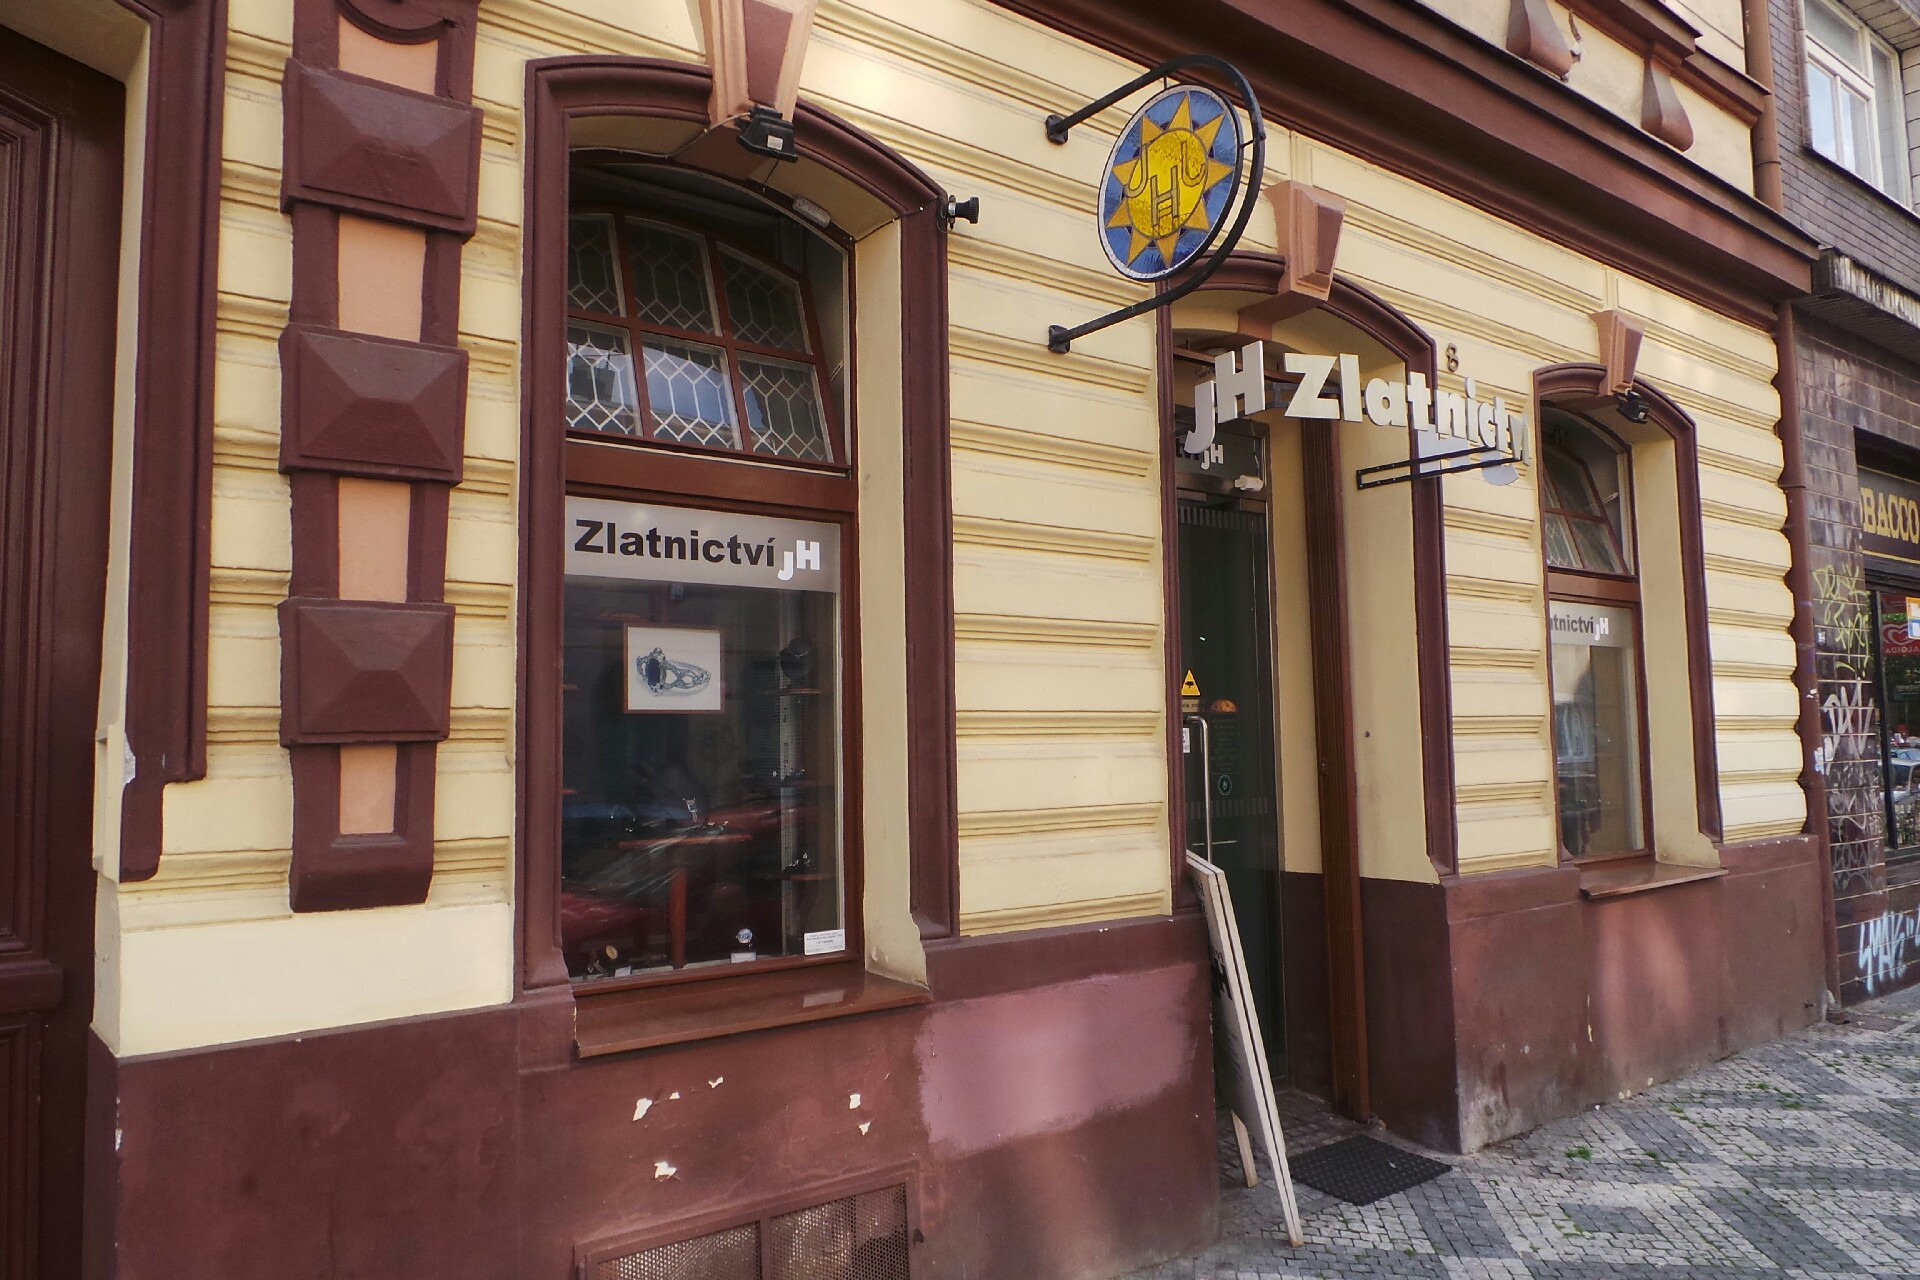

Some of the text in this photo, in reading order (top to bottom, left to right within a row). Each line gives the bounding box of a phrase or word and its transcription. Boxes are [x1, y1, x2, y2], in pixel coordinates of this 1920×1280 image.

[1445, 342, 1459, 373] 8
[1859, 487, 1920, 545] BACCO
[574, 519, 776, 567] Zlatnictví
